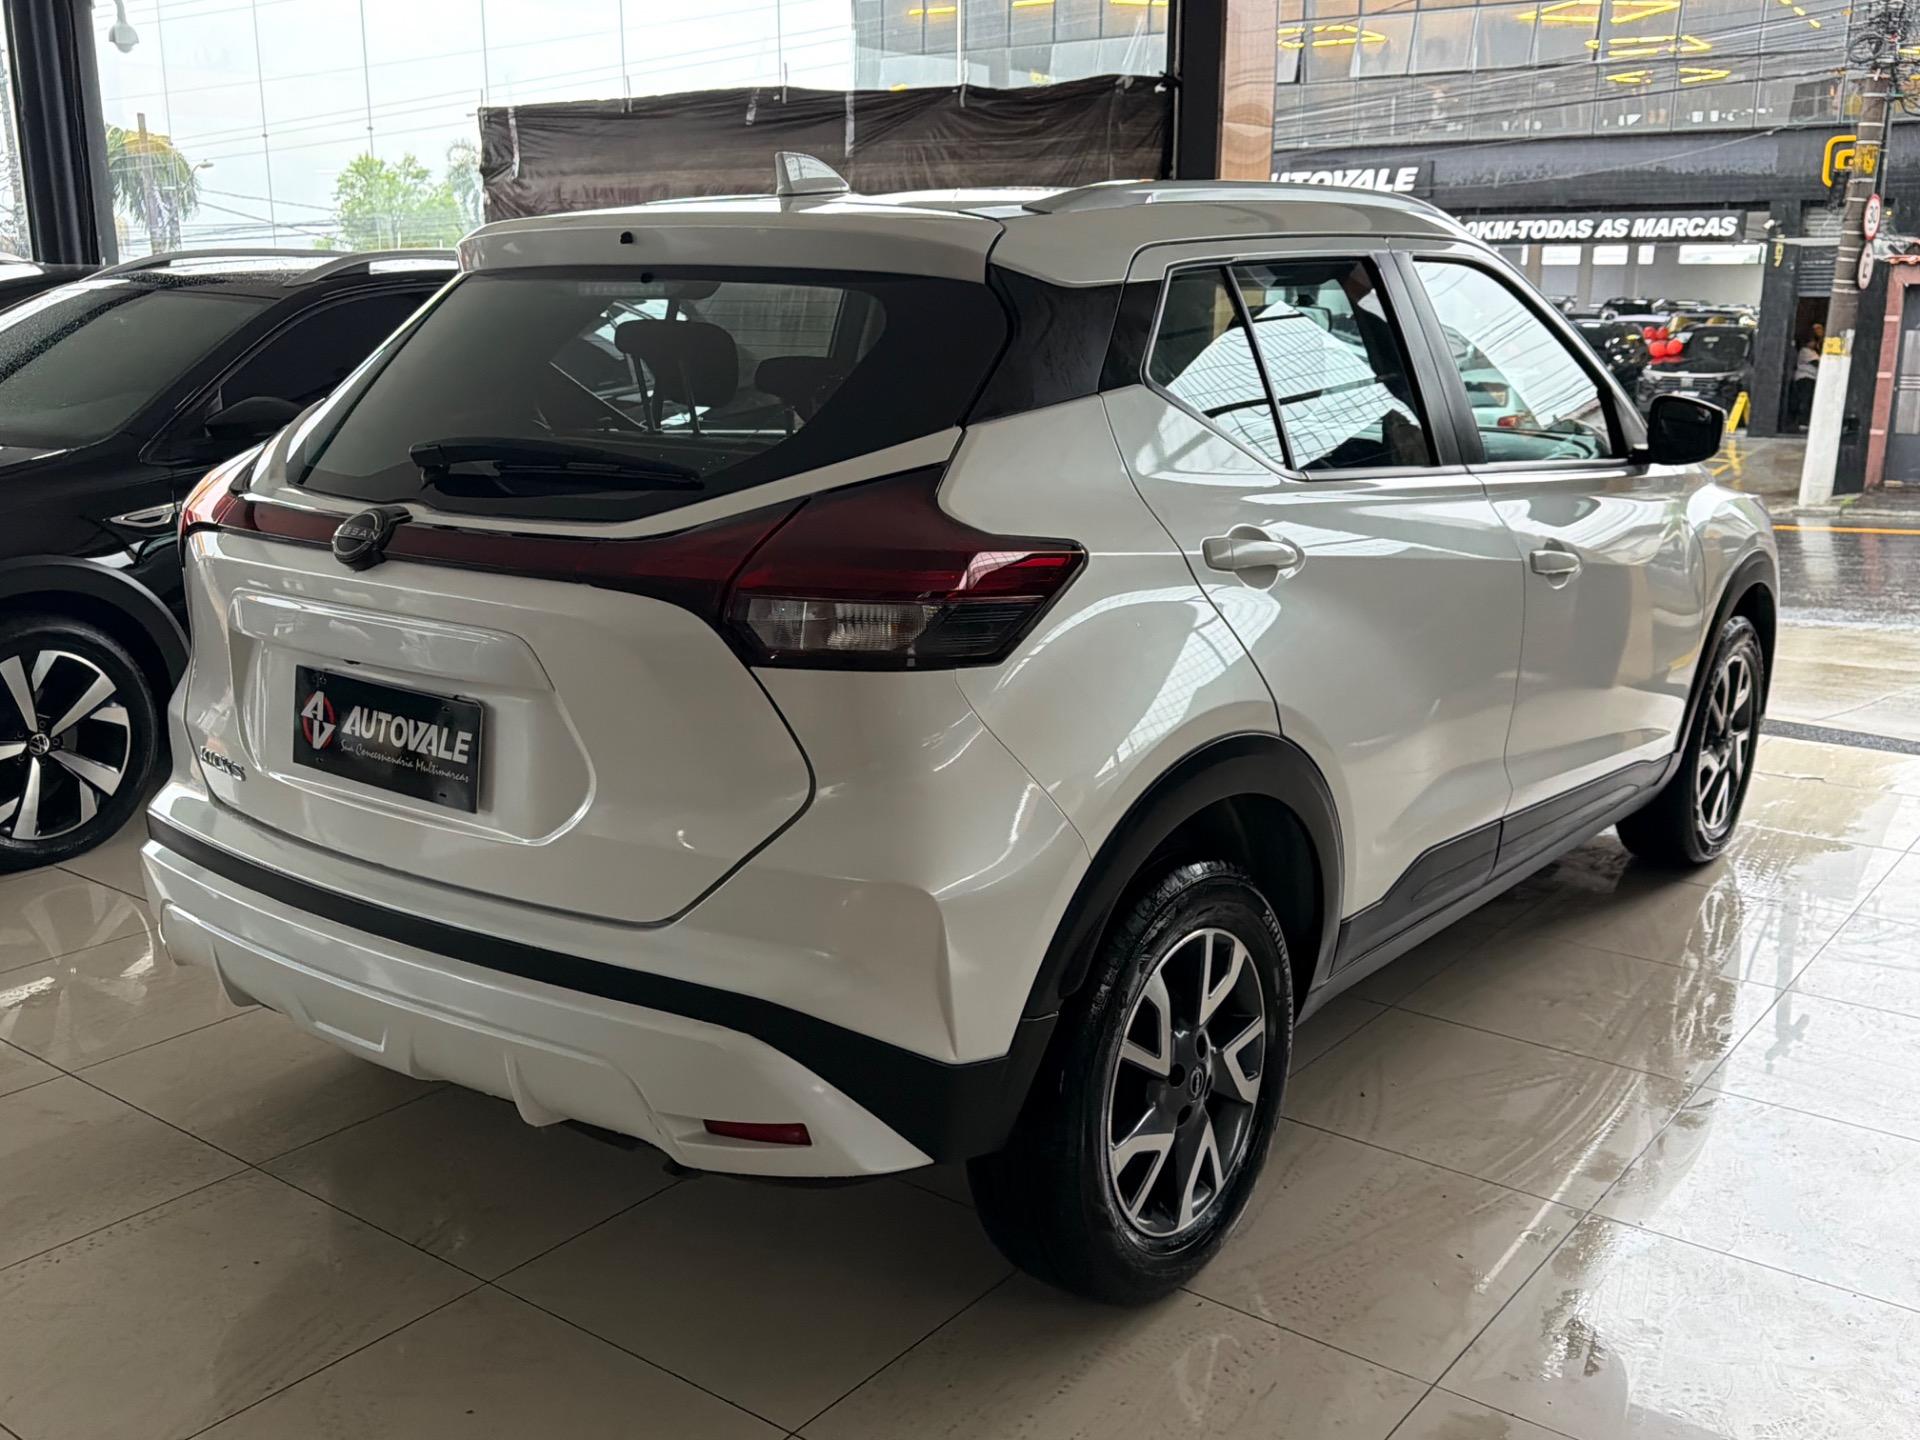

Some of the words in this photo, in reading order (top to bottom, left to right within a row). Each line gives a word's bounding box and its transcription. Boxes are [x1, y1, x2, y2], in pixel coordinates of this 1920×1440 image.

[1594, 218, 1630, 239] AS
[1630, 216, 1738, 238] MARCAS
[341, 705, 473, 764] AUTOVALE
